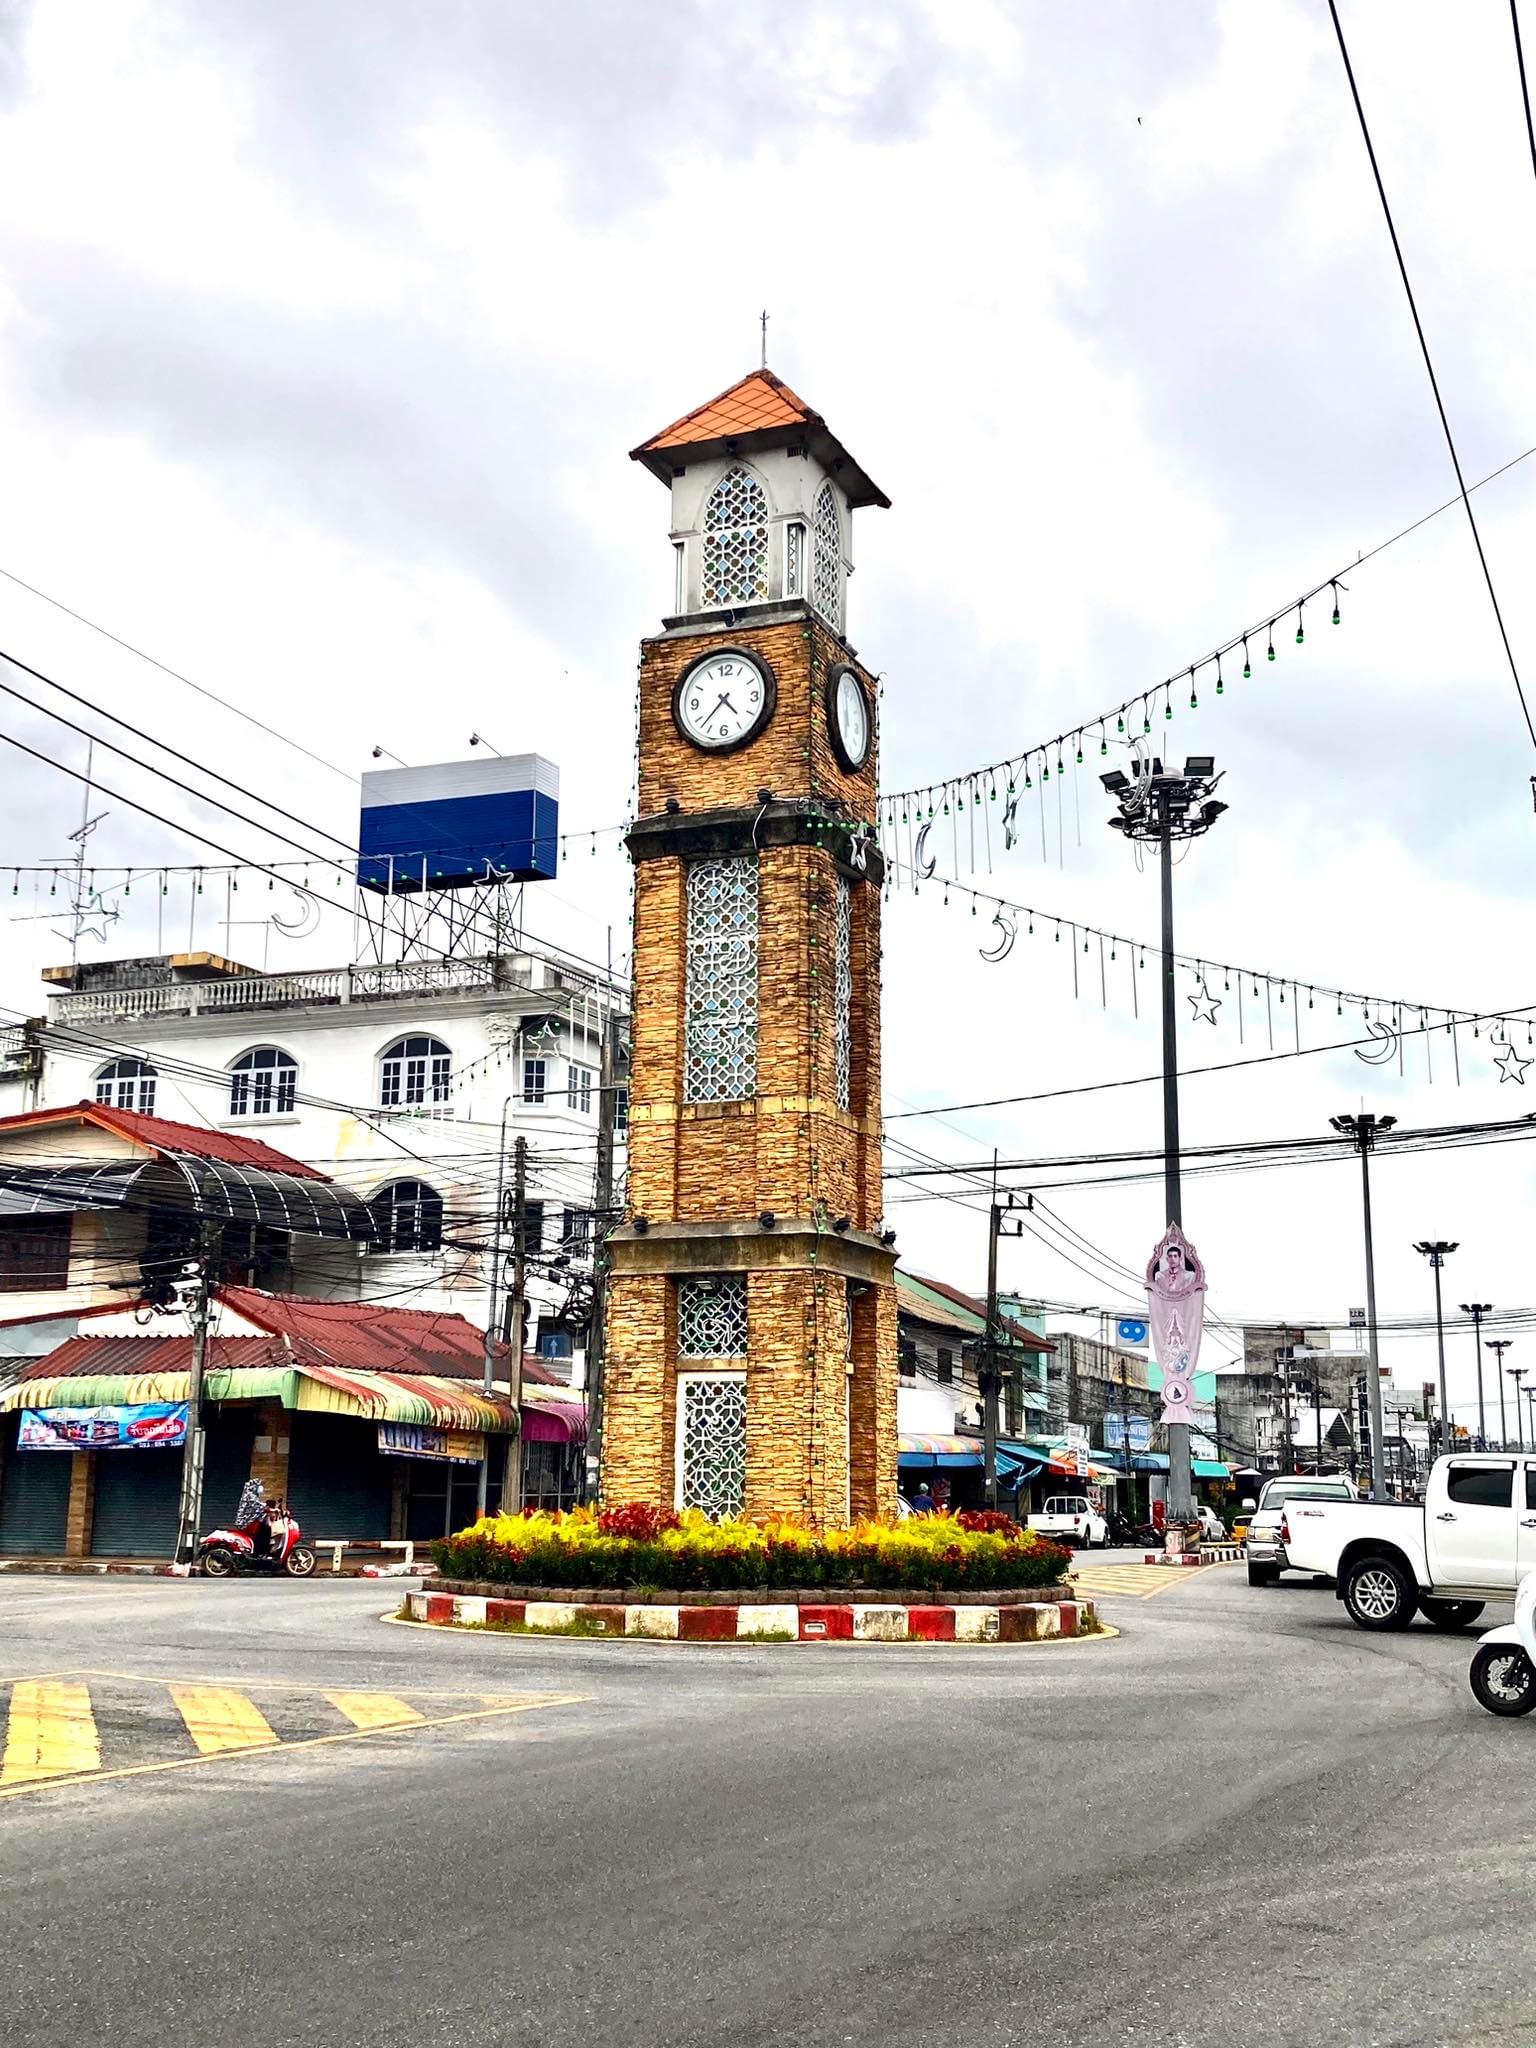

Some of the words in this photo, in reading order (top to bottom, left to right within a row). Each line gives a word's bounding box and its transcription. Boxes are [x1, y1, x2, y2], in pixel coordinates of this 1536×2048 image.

[717, 664, 733, 676] 12
[750, 691, 760, 703] 3
[690, 698, 699, 710] 9
[719, 725, 728, 736] 6
